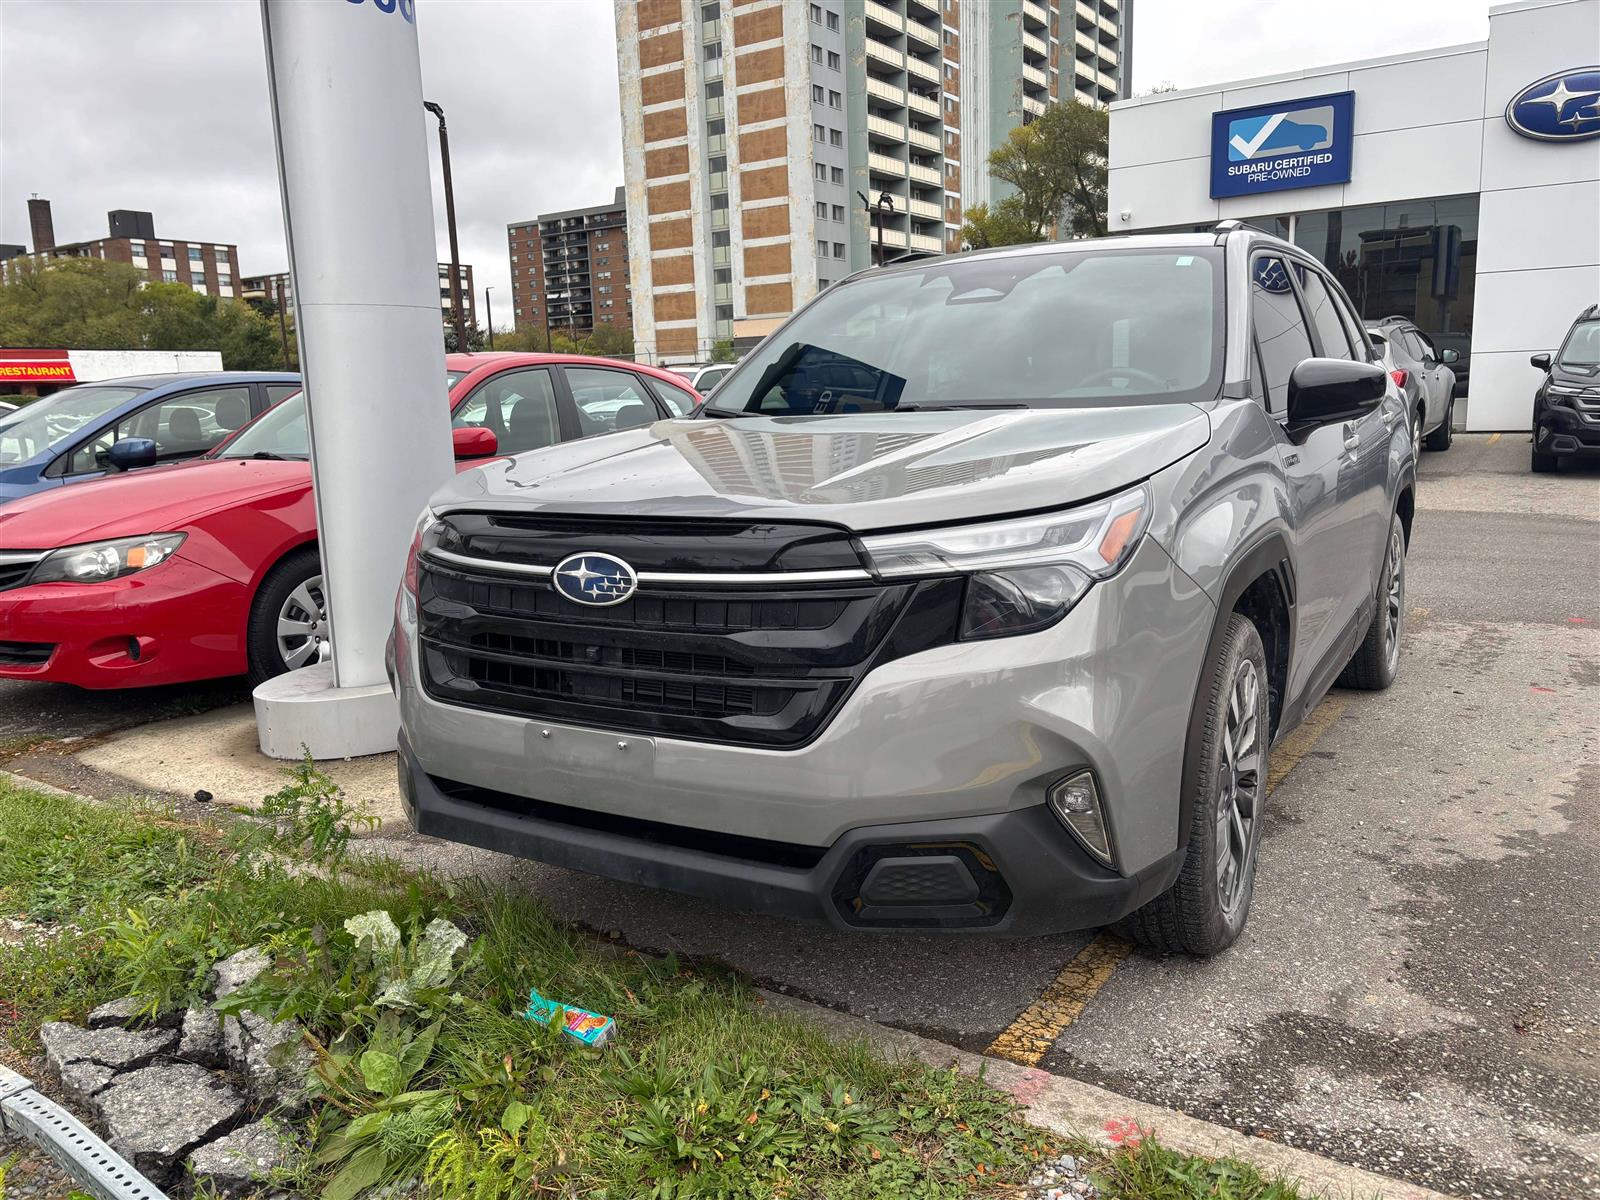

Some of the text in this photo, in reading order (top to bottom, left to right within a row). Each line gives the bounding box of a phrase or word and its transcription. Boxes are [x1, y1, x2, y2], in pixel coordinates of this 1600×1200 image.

[1228, 153, 1333, 176] SUBARU CERTIFIED
[1247, 166, 1311, 183] PRE-OWNED
[0, 366, 71, 376] RESTAURANT
